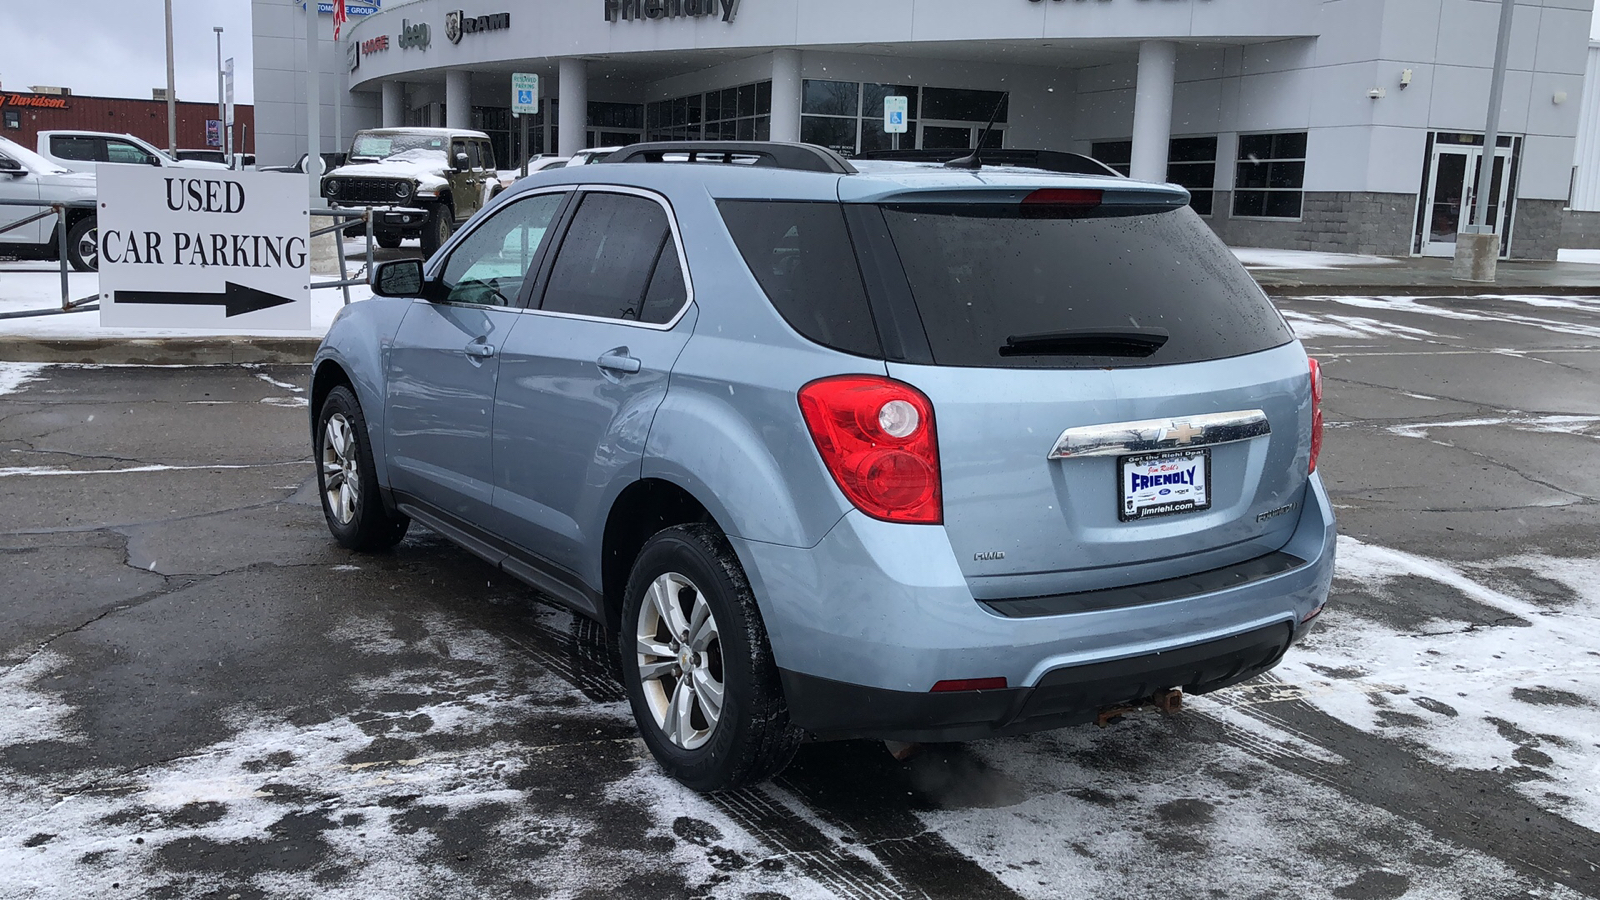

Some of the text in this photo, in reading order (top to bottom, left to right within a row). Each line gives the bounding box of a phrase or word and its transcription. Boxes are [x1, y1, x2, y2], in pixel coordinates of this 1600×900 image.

[351, 7, 374, 15] GROUP
[463, 13, 510, 33] RAM
[398, 19, 431, 51] Jeep
[164, 178, 245, 213] USED
[102, 230, 307, 269] CAR PARKING
[1132, 465, 1196, 493] FRIENDLY
[1147, 466, 1158, 475] Jim
[1141, 503, 1193, 516] jimriehl.com
[974, 551, 1005, 561] AWD
